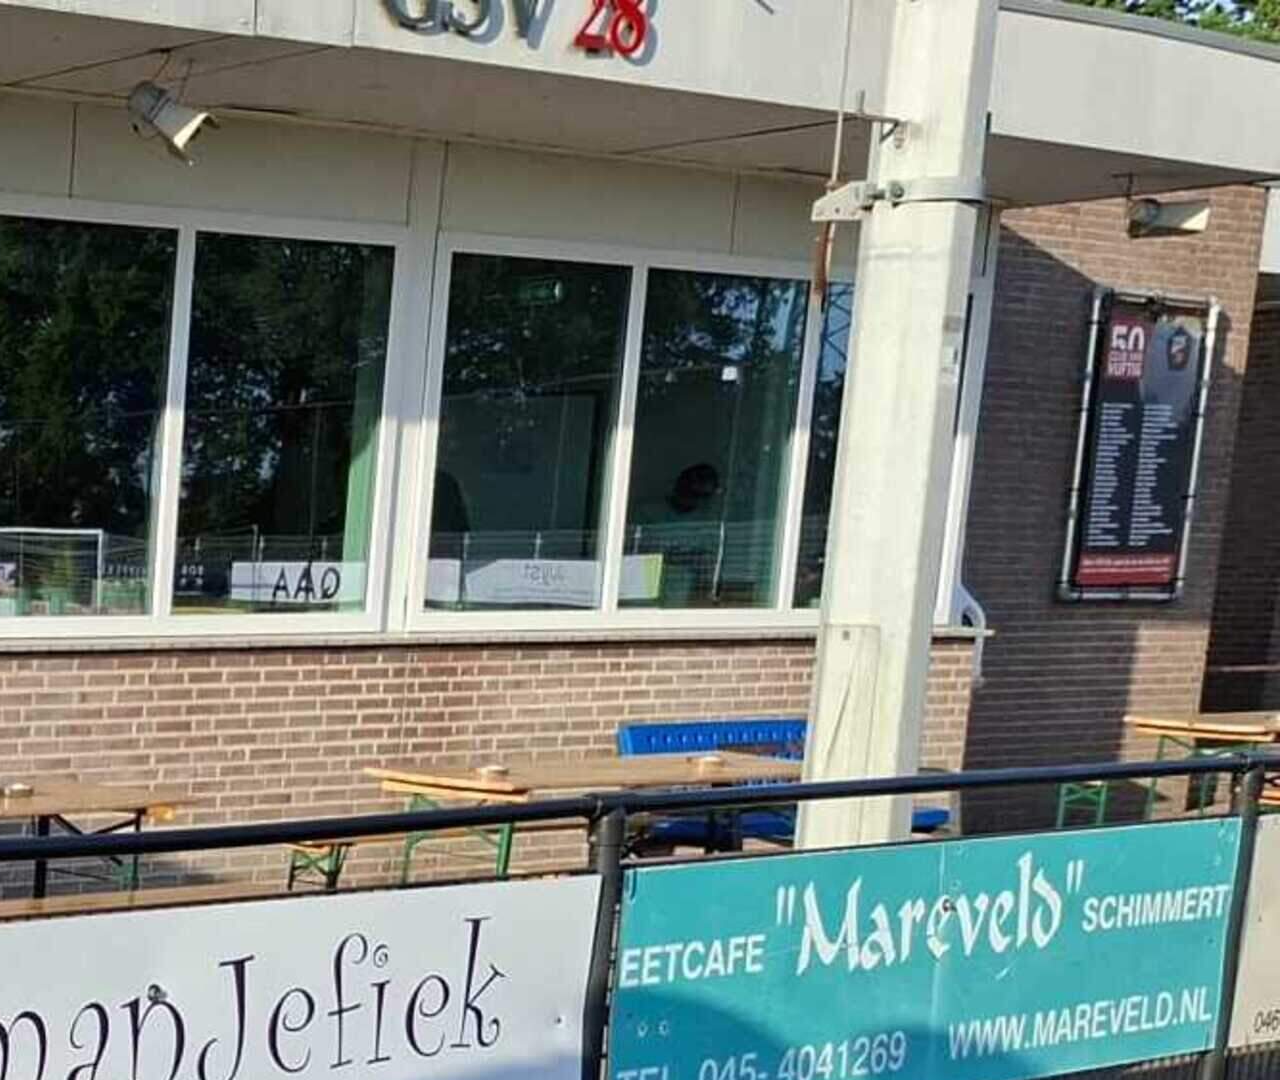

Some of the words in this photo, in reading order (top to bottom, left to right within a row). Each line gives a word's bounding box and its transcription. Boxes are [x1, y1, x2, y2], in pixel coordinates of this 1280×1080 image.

[572, 0, 647, 56] 28
[619, 934, 766, 988] EETCAFE
[775, 851, 1084, 976] "Mareveld"
[1082, 884, 1233, 933] SCHIMMERT
[948, 986, 1213, 1060] WWW.MAREVELD.NL
